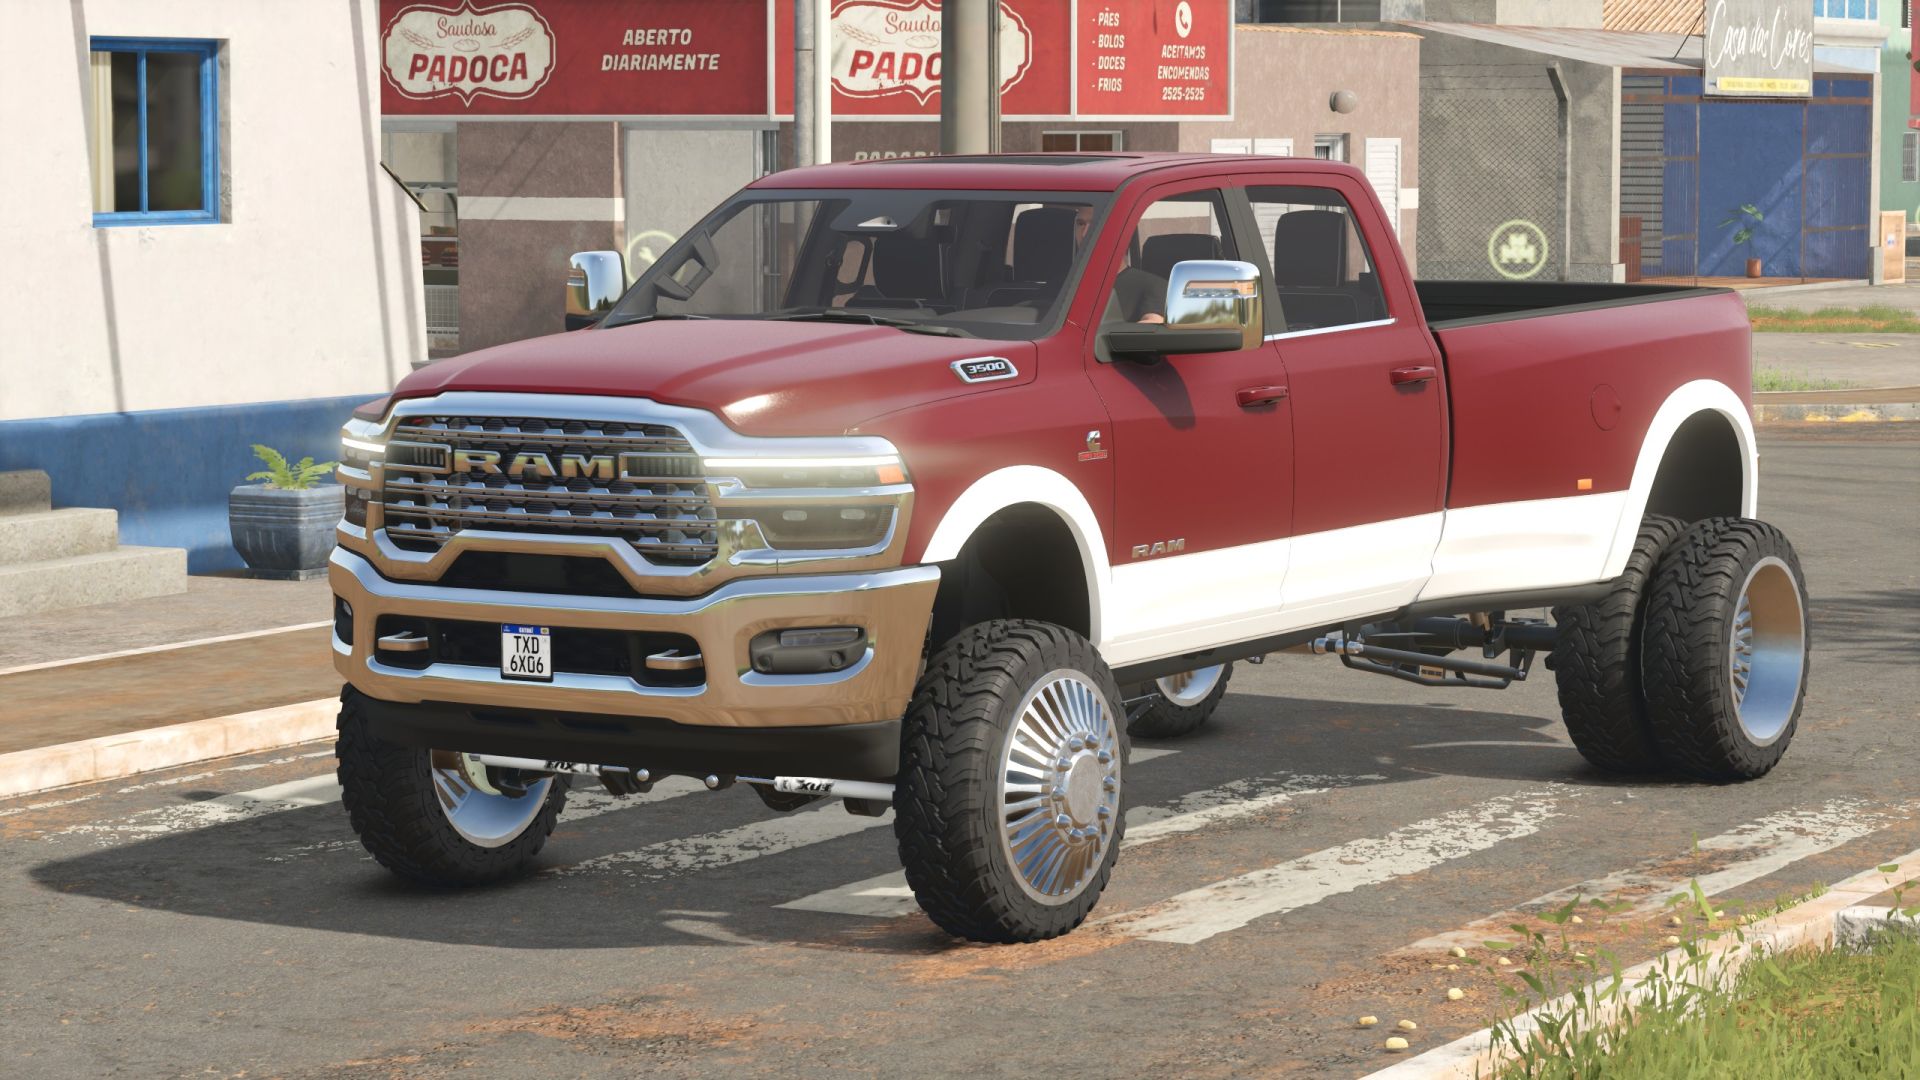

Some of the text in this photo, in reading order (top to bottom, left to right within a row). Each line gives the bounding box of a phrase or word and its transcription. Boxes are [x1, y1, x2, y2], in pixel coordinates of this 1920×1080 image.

[437, 15, 497, 39] Saudosa
[885, 11, 942, 35] Saudo
[622, 28, 692, 46] ABERTO
[1098, 34, 1125, 49] BOLOS
[1708, 0, 1747, 69] Casa
[1161, 44, 1206, 60] ACEITAMOS
[408, 52, 528, 83] PADOCA
[600, 53, 721, 71] DIARIAMENTE
[848, 49, 942, 81] PADO
[1098, 55, 1126, 70] DOCES
[1157, 65, 1210, 81] ENCOMENDAS
[1098, 77, 1122, 92] FRIOS
[1161, 86, 1205, 101] 2525-2525
[966, 361, 1006, 374] 3500
[453, 448, 616, 480] RAM
[1132, 538, 1185, 559] RAM
[513, 635, 540, 654] TXD
[510, 654, 544, 674] 6X06
